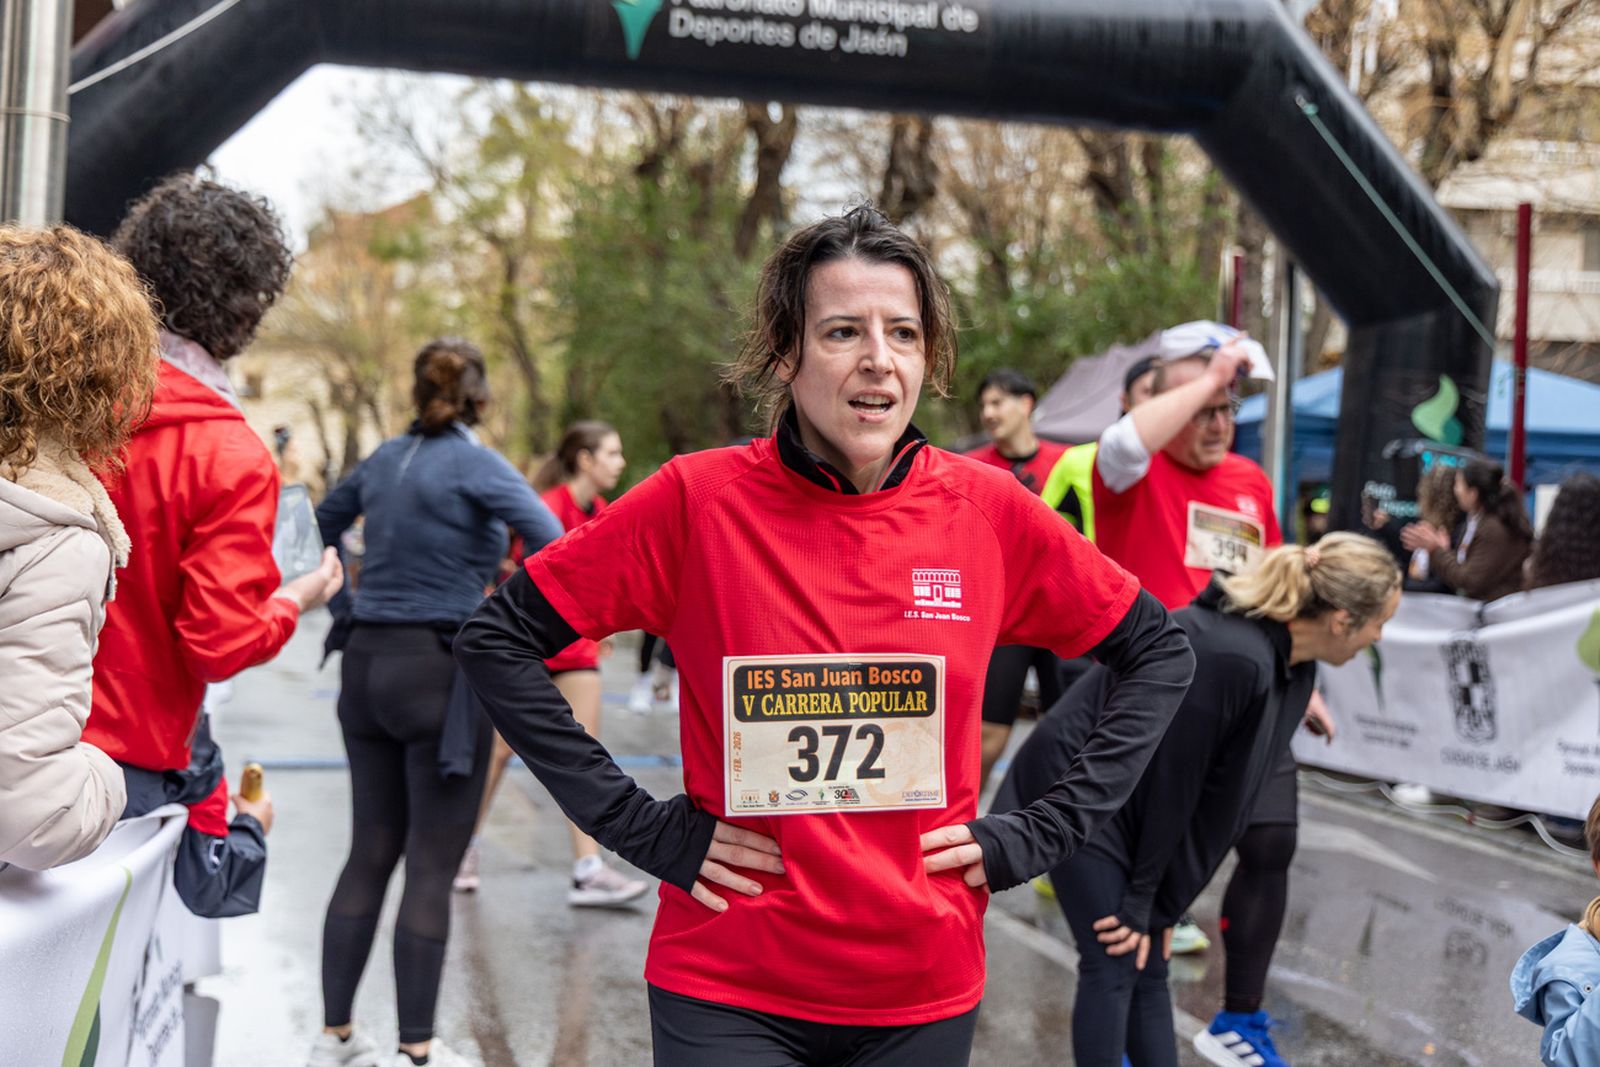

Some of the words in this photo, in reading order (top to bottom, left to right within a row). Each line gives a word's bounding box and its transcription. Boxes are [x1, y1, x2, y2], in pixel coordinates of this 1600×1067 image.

[941, 2, 979, 33] de
[669, 7, 796, 47] Deportes
[798, 19, 837, 51] de
[839, 23, 908, 57] Jaén
[921, 611, 934, 619] San
[935, 612, 951, 620] Juan
[951, 612, 971, 622] Bosco
[747, 670, 775, 690] IES
[781, 668, 815, 688] San
[821, 667, 862, 687] Juan
[868, 666, 923, 686] Bosco
[742, 695, 756, 716] V
[761, 692, 843, 716] CARRERA
[848, 690, 928, 712] POPULAR
[787, 723, 886, 783] 372
